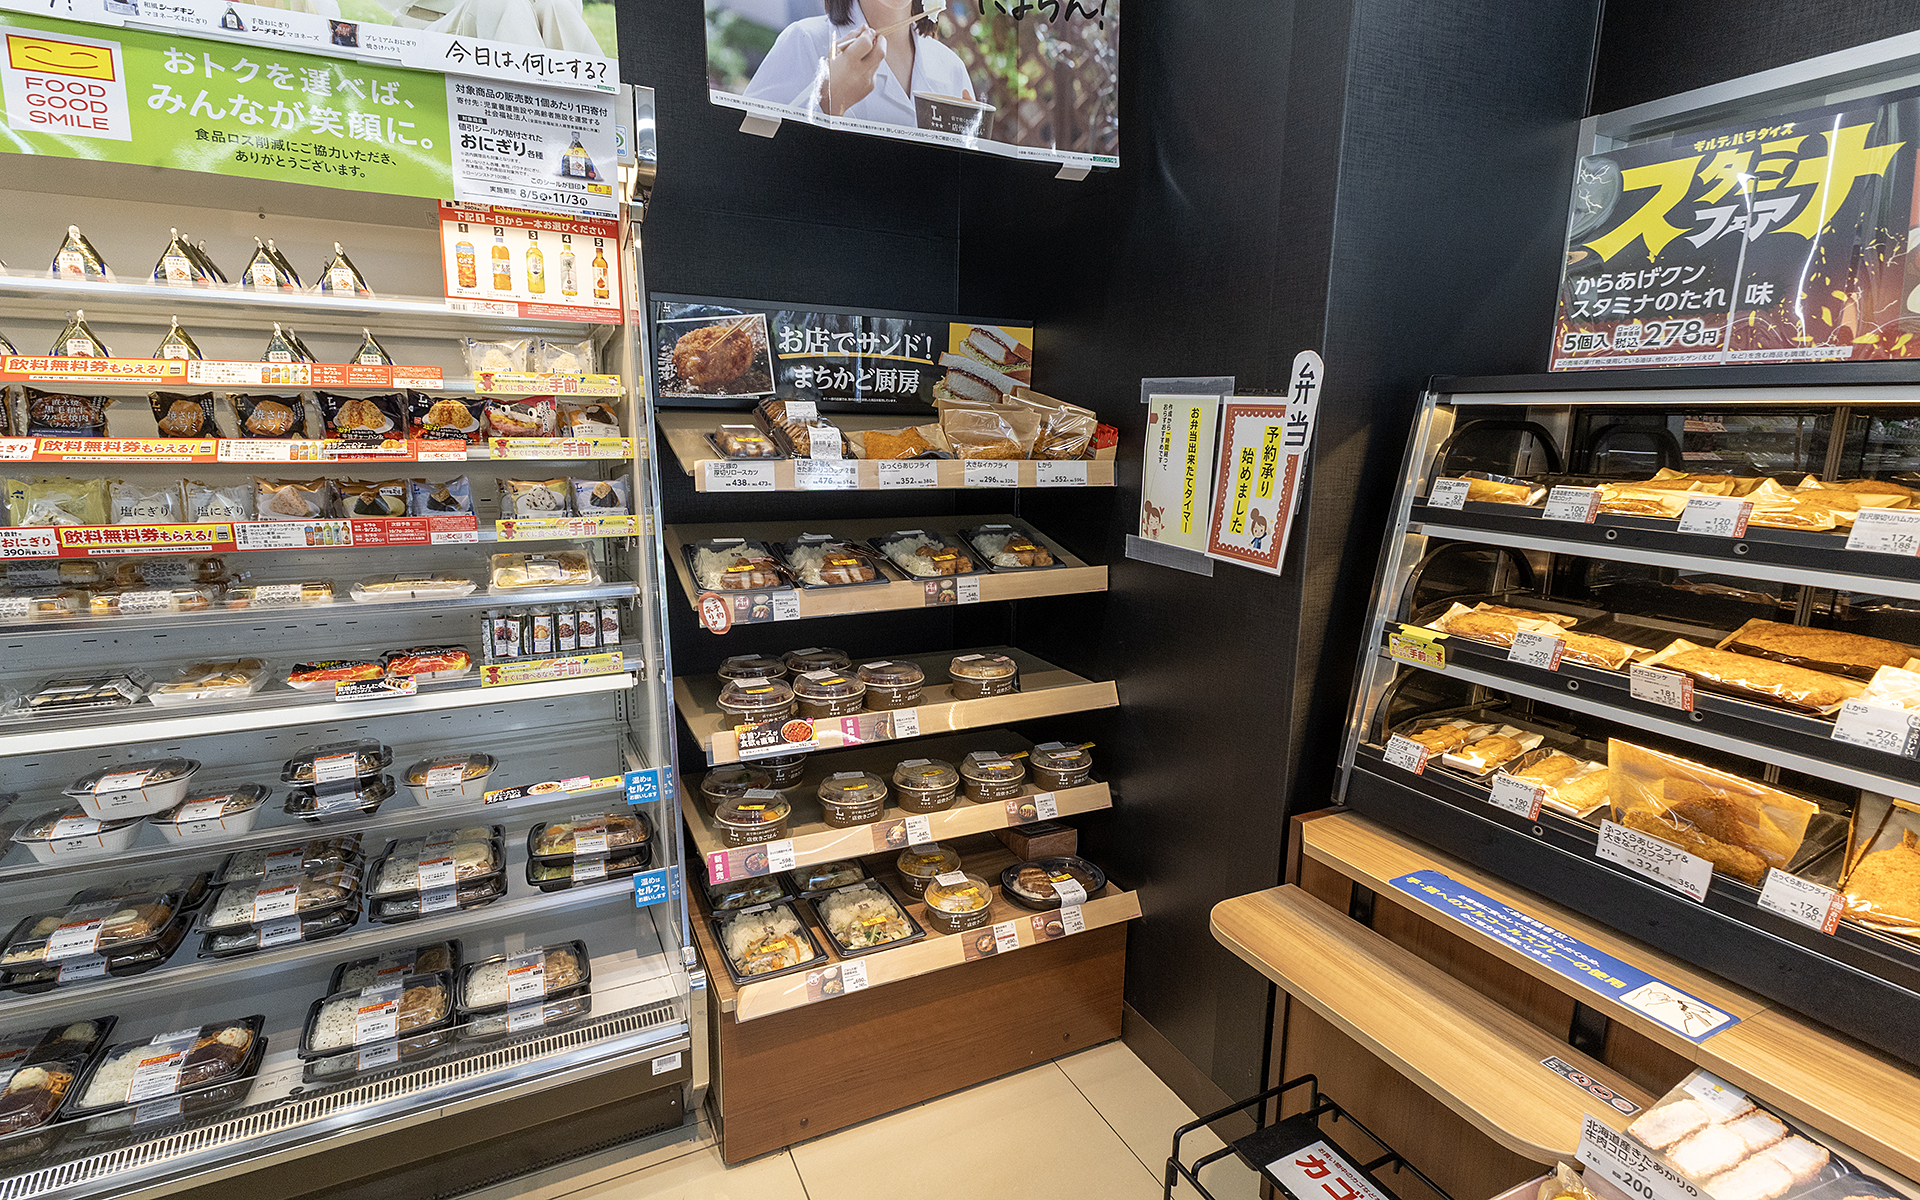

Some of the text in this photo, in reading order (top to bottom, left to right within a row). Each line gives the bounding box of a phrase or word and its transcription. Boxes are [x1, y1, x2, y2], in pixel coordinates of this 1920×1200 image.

[446, 40, 607, 83] 今日は、何にする?
[25, 76, 106, 97] FOOD
[163, 46, 415, 109] おトクを選べば、
[26, 94, 108, 114] GOOD
[455, 83, 608, 117] 対象商品の販売数1個あたり1円寄付
[29, 110, 109, 130] SMILE
[147, 84, 434, 149] みんなが笑顔に。
[195, 128, 398, 167] 食品ロス削減にご協力いただき、
[235, 151, 368, 178] ありがとうございます。
[1582, 121, 1907, 264] スタミナ
[1685, 194, 1800, 249] フェア
[1575, 264, 1707, 296] からあげクン
[1570, 282, 1774, 320] スタミナのたれ 味
[778, 326, 933, 360] お店でサンド!
[1563, 334, 1610, 352] 5個入
[1645, 318, 1717, 348] 278円
[9, 359, 165, 374] 飲料無料券もらえる!
[793, 365, 921, 394] まちかど厨房
[252, 409, 288, 421] 焼さけ
[1284, 362, 1316, 447] 弁当
[167, 410, 198, 421] 焼さけ
[169, 423, 199, 433] ハラミ
[255, 422, 286, 432] ハラミ
[43, 440, 197, 454] 飲料無料券もらえる!
[966, 461, 1009, 469] 大きなイカフライ
[1181, 407, 1200, 533] お弁当出来たてタイマー
[1260, 426, 1280, 498] 予約承り
[1231, 447, 1255, 534] 始めました
[120, 505, 170, 518] 塩にぎり
[197, 505, 244, 518] 塩にぎり
[1688, 499, 1722, 507] 牛肉メンチ
[1713, 517, 1731, 526] 120
[1, 536, 51, 548] おにぎり
[63, 528, 212, 545] 飲料無料券もらえる!
[1891, 534, 1914, 543] 174
[1893, 542, 1911, 550] 188
[1631, 668, 1668, 680] メガコロッケ
[1660, 689, 1676, 697] 181
[1846, 703, 1869, 714] Lから
[1875, 729, 1899, 741] 276
[1878, 737, 1896, 747] 298
[1497, 776, 1533, 792] 大きなイカフライ
[1514, 797, 1528, 807] 190
[1603, 832, 1674, 865] 大きなイカフライ
[1604, 824, 1689, 864] ふっくらあじフライ&
[714, 855, 725, 881] 新発売
[1635, 858, 1696, 891] 324 350
[1771, 871, 1828, 897] ふっくらあじフライ
[1799, 901, 1820, 915] 176
[1801, 910, 1817, 921] 190
[1405, 876, 1628, 990] 手・指へのアルコールスプレーの使用
[1584, 1128, 1649, 1173] 牛肉コロッケ
[1586, 1119, 1698, 1198] 北海道産きたあかりの
[1622, 1172, 1654, 1199] 200
